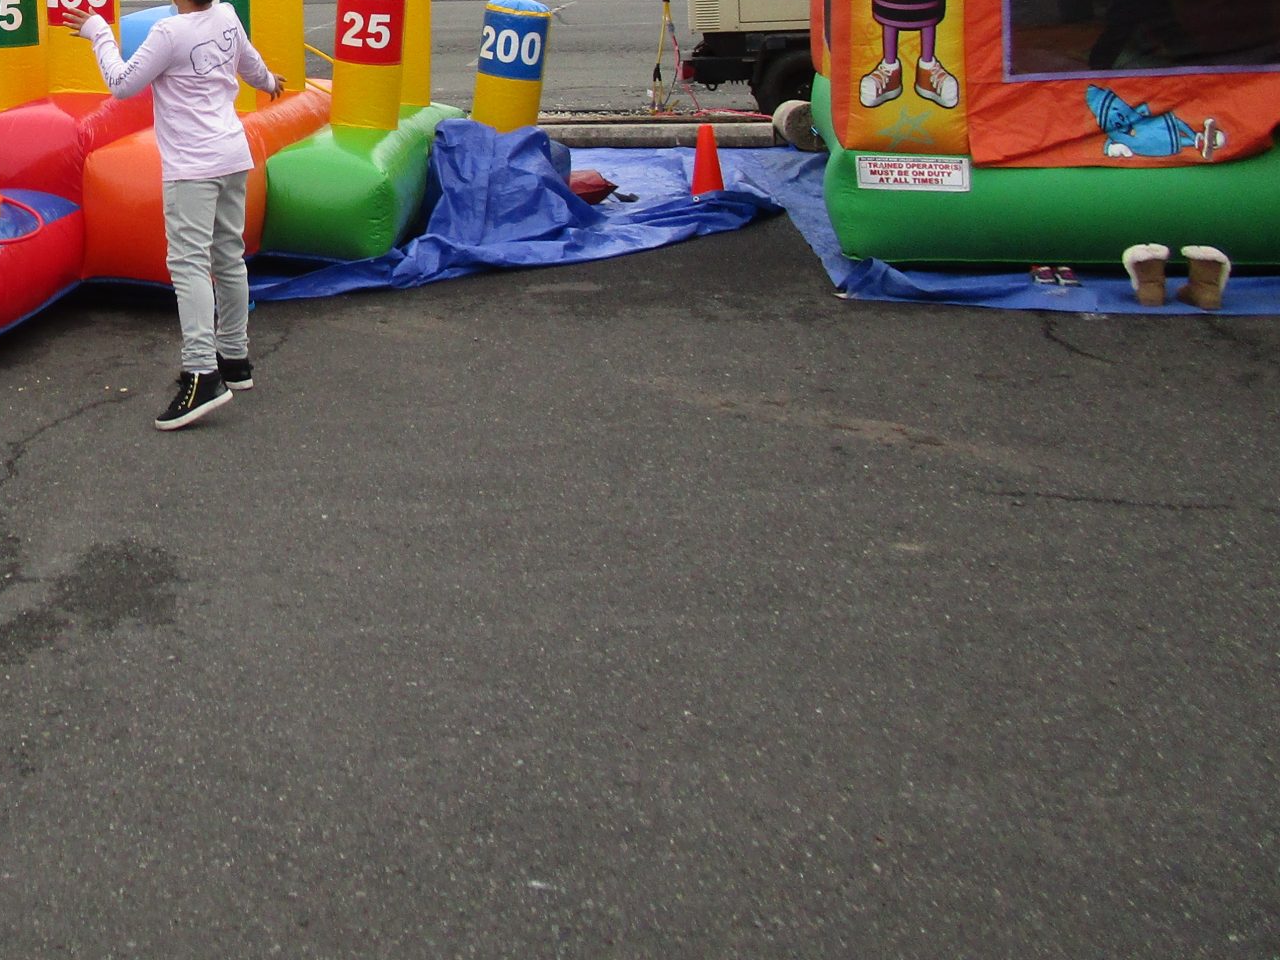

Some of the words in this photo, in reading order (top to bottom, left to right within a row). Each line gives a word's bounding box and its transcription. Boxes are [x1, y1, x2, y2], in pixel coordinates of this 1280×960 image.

[341, 11, 391, 49] 25
[480, 25, 541, 66] 200
[906, 162, 961, 171] OPERATOR(S)
